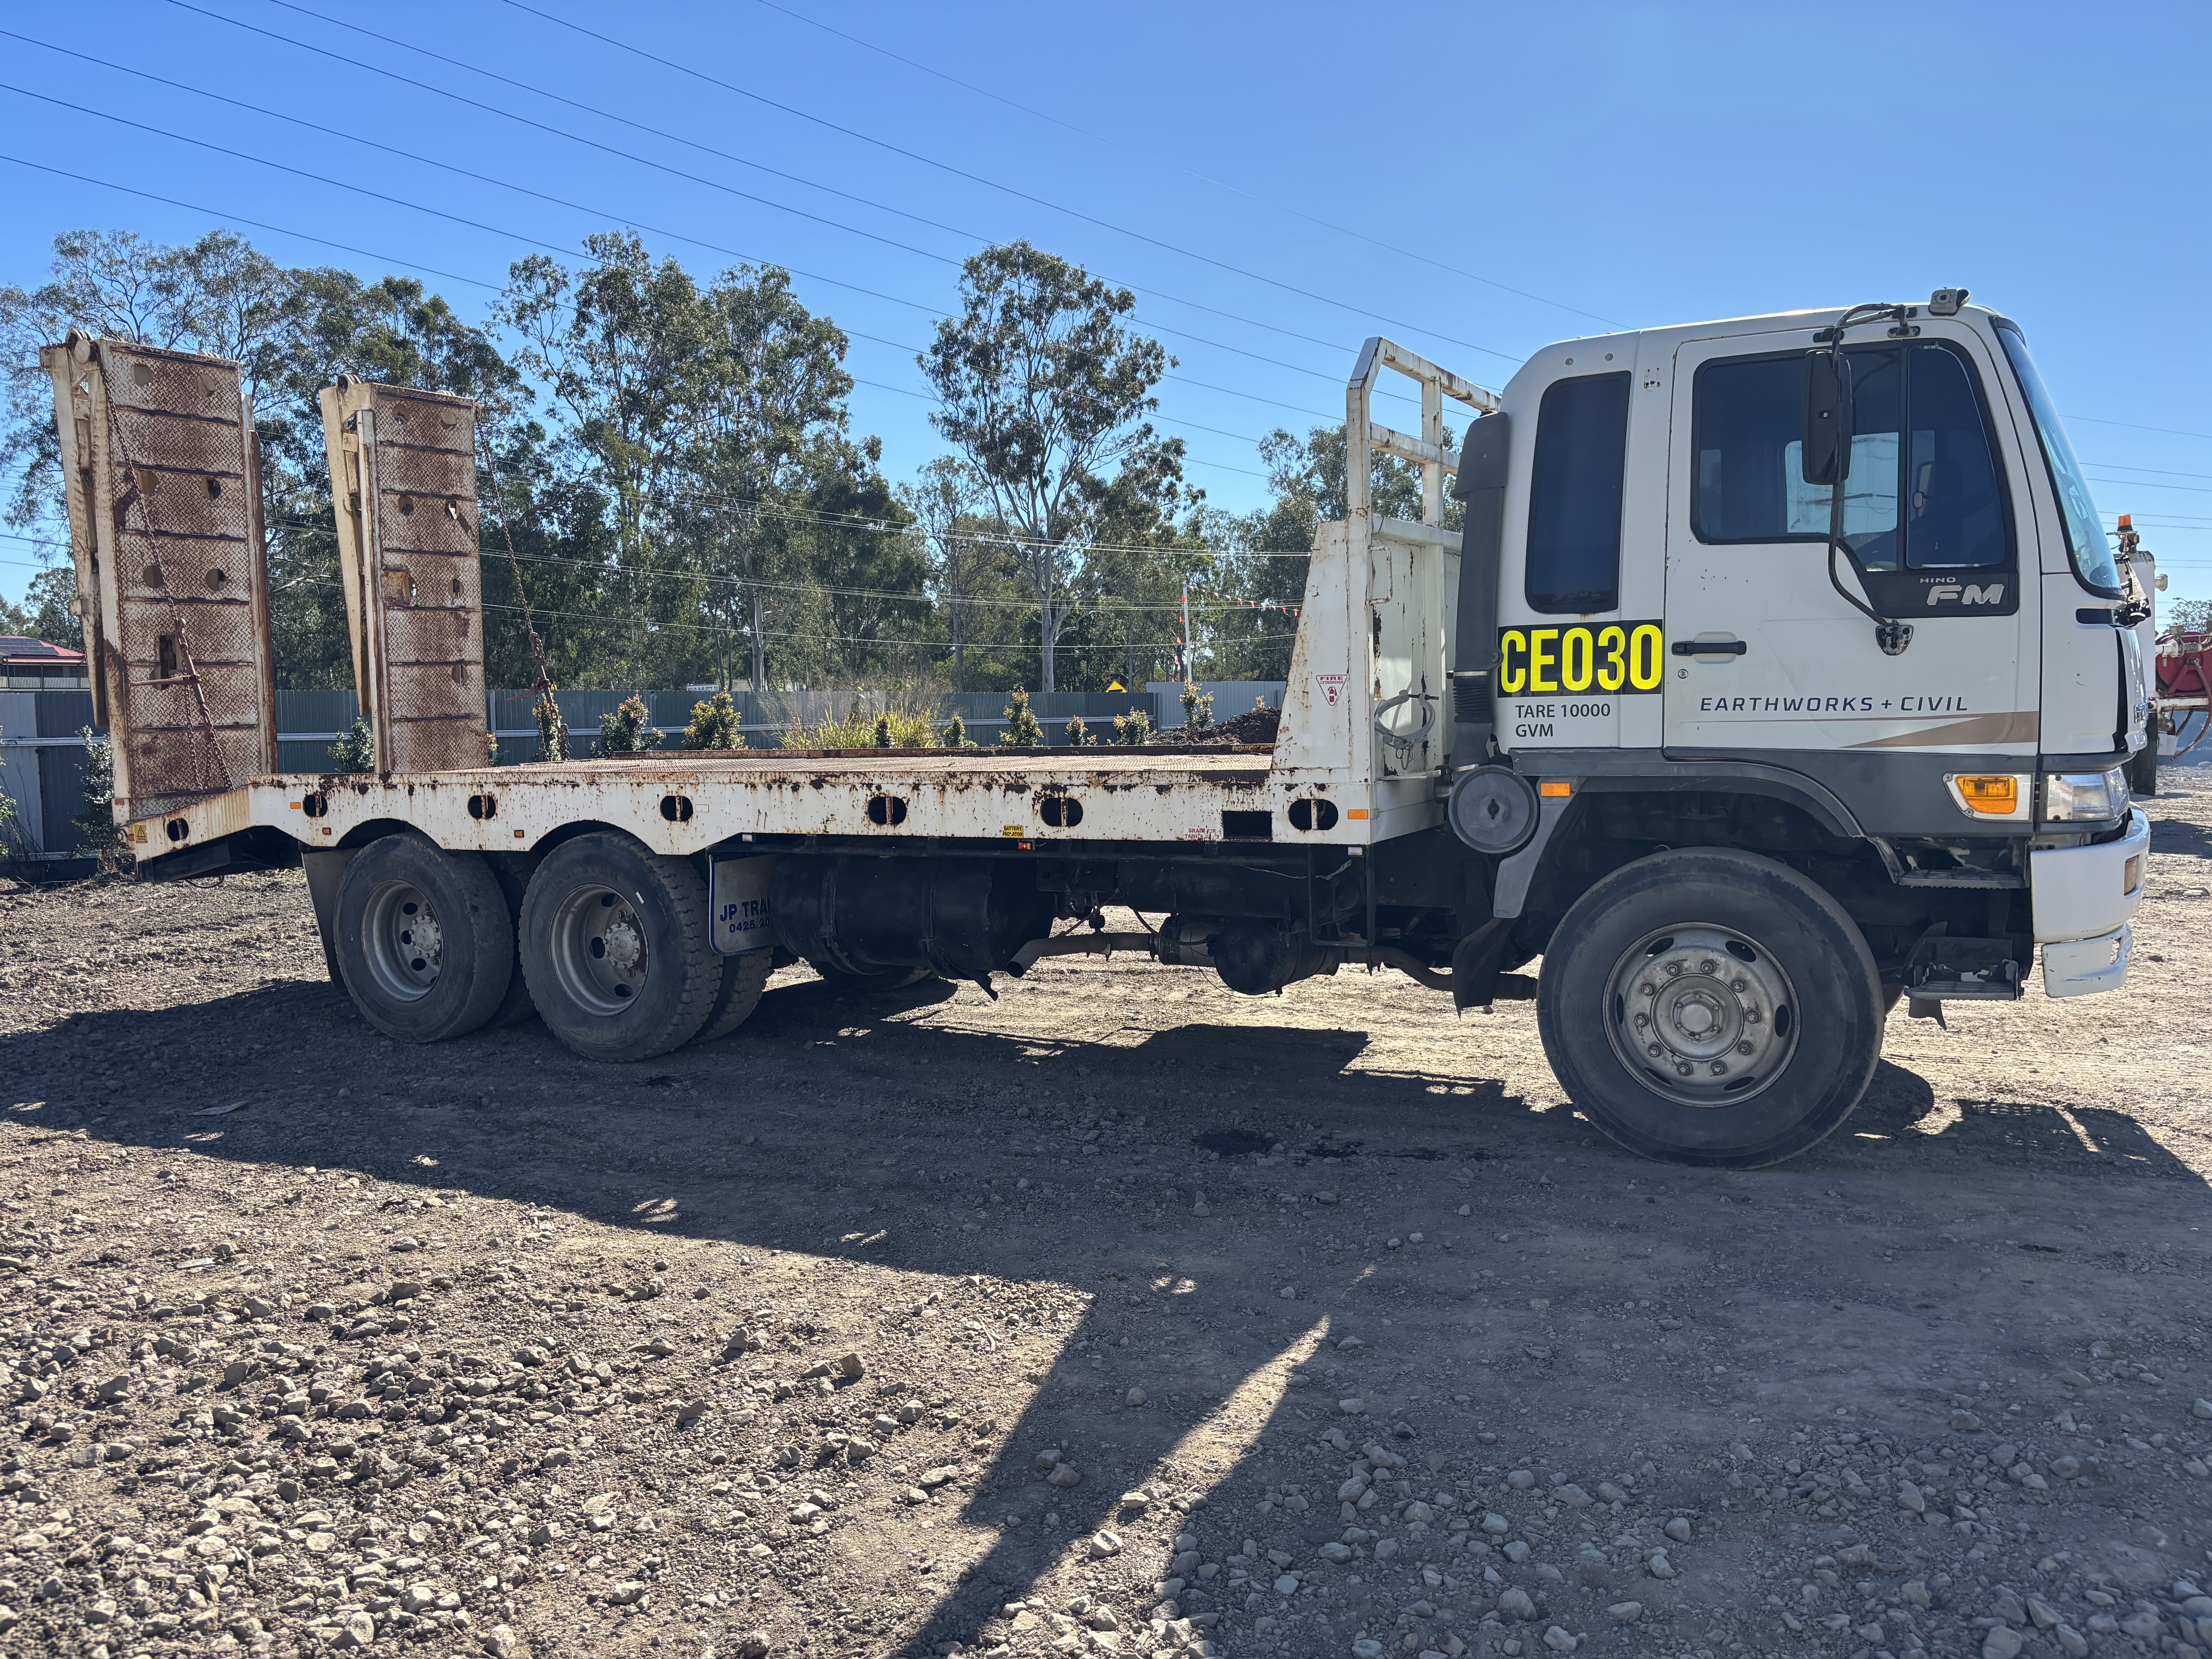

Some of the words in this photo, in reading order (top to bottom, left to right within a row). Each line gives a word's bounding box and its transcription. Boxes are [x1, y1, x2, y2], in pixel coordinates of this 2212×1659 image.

[1926, 584, 2004, 605] FM
[1515, 704, 1555, 718] TARE
[1561, 703, 1611, 717] 10000
[1700, 697, 1873, 711] EARTHWORKS
[1881, 700, 1892, 709] +
[1900, 697, 1968, 711] CIVIL
[1515, 723, 1553, 737] GVM
[720, 903, 737, 922] JP
[729, 920, 755, 933] 0425
